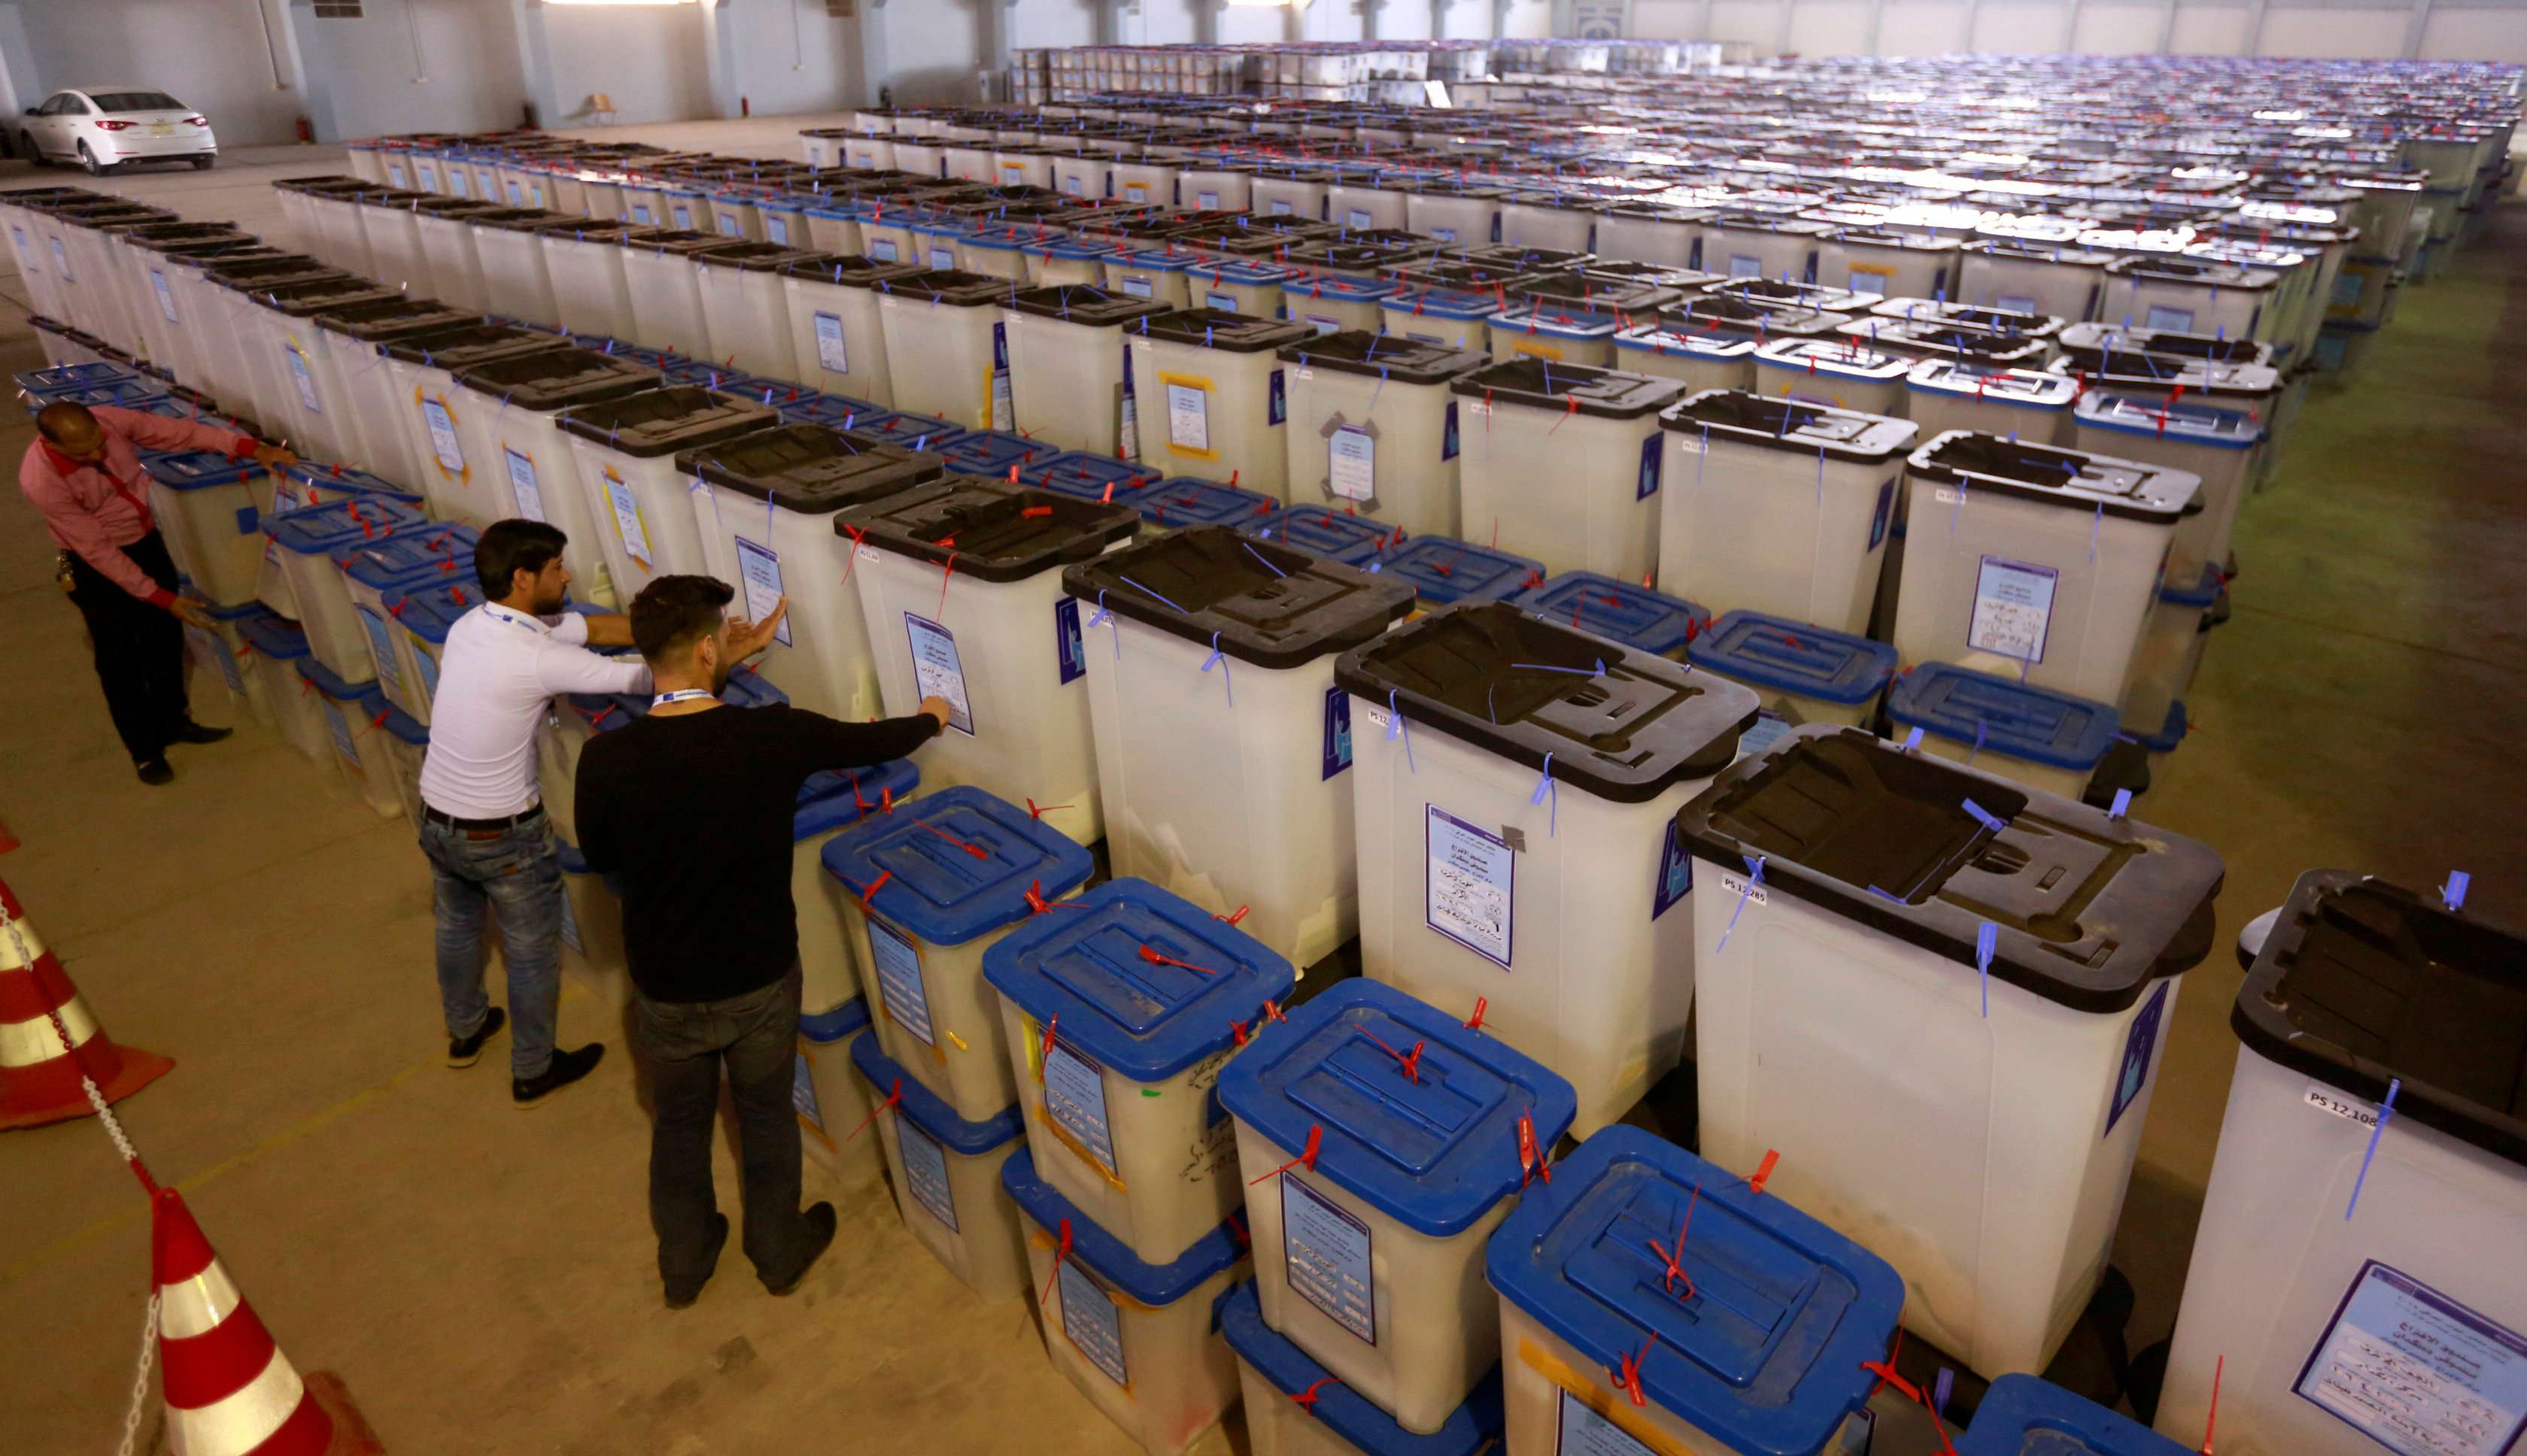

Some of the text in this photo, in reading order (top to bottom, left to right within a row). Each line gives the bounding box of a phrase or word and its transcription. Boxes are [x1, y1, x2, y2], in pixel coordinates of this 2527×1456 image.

[1370, 711, 1378, 720] PS
[1725, 878, 1736, 889] PS
[2310, 1093, 2377, 1127] PS 12.108
